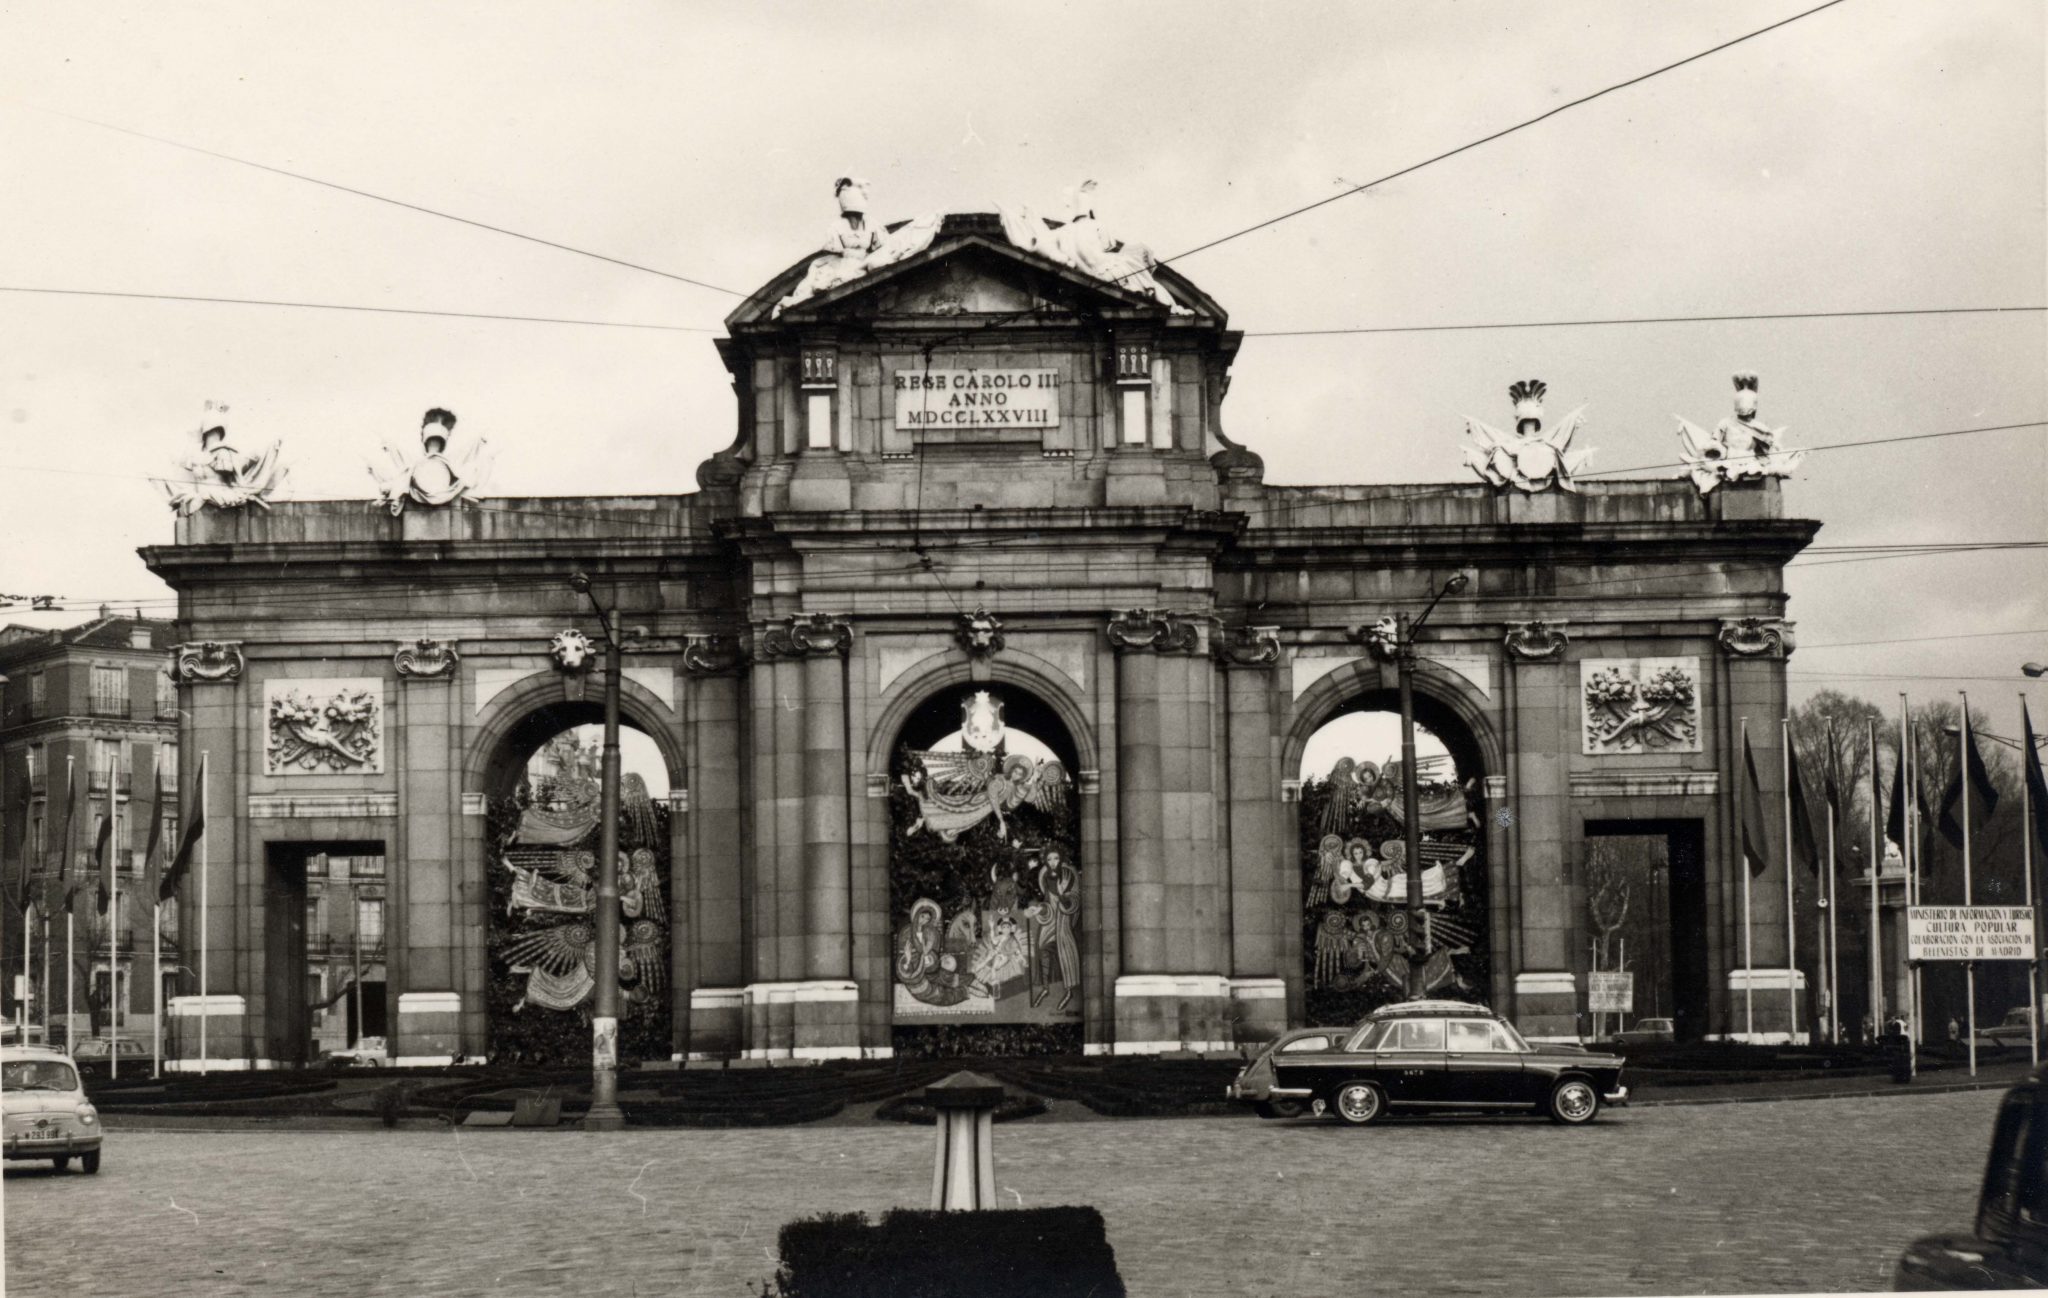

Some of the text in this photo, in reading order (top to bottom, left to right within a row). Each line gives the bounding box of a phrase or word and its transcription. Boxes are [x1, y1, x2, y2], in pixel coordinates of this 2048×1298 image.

[895, 373, 1060, 390] REGE CAROLO III
[949, 392, 1008, 406] ANNO
[908, 408, 1048, 424] MDCCLXXVIII
[1910, 908, 1948, 920] MINISTERIO
[1949, 908, 1957, 920] DE
[2009, 908, 2033, 920] TURISMO
[1926, 921, 2017, 933] CULTURA POPULAR
[1960, 934, 1974, 945] CON
[1975, 934, 1985, 945] LA
[2024, 934, 2032, 945] DE
[1922, 946, 2022, 957] BELENISTAS DE MADRID
